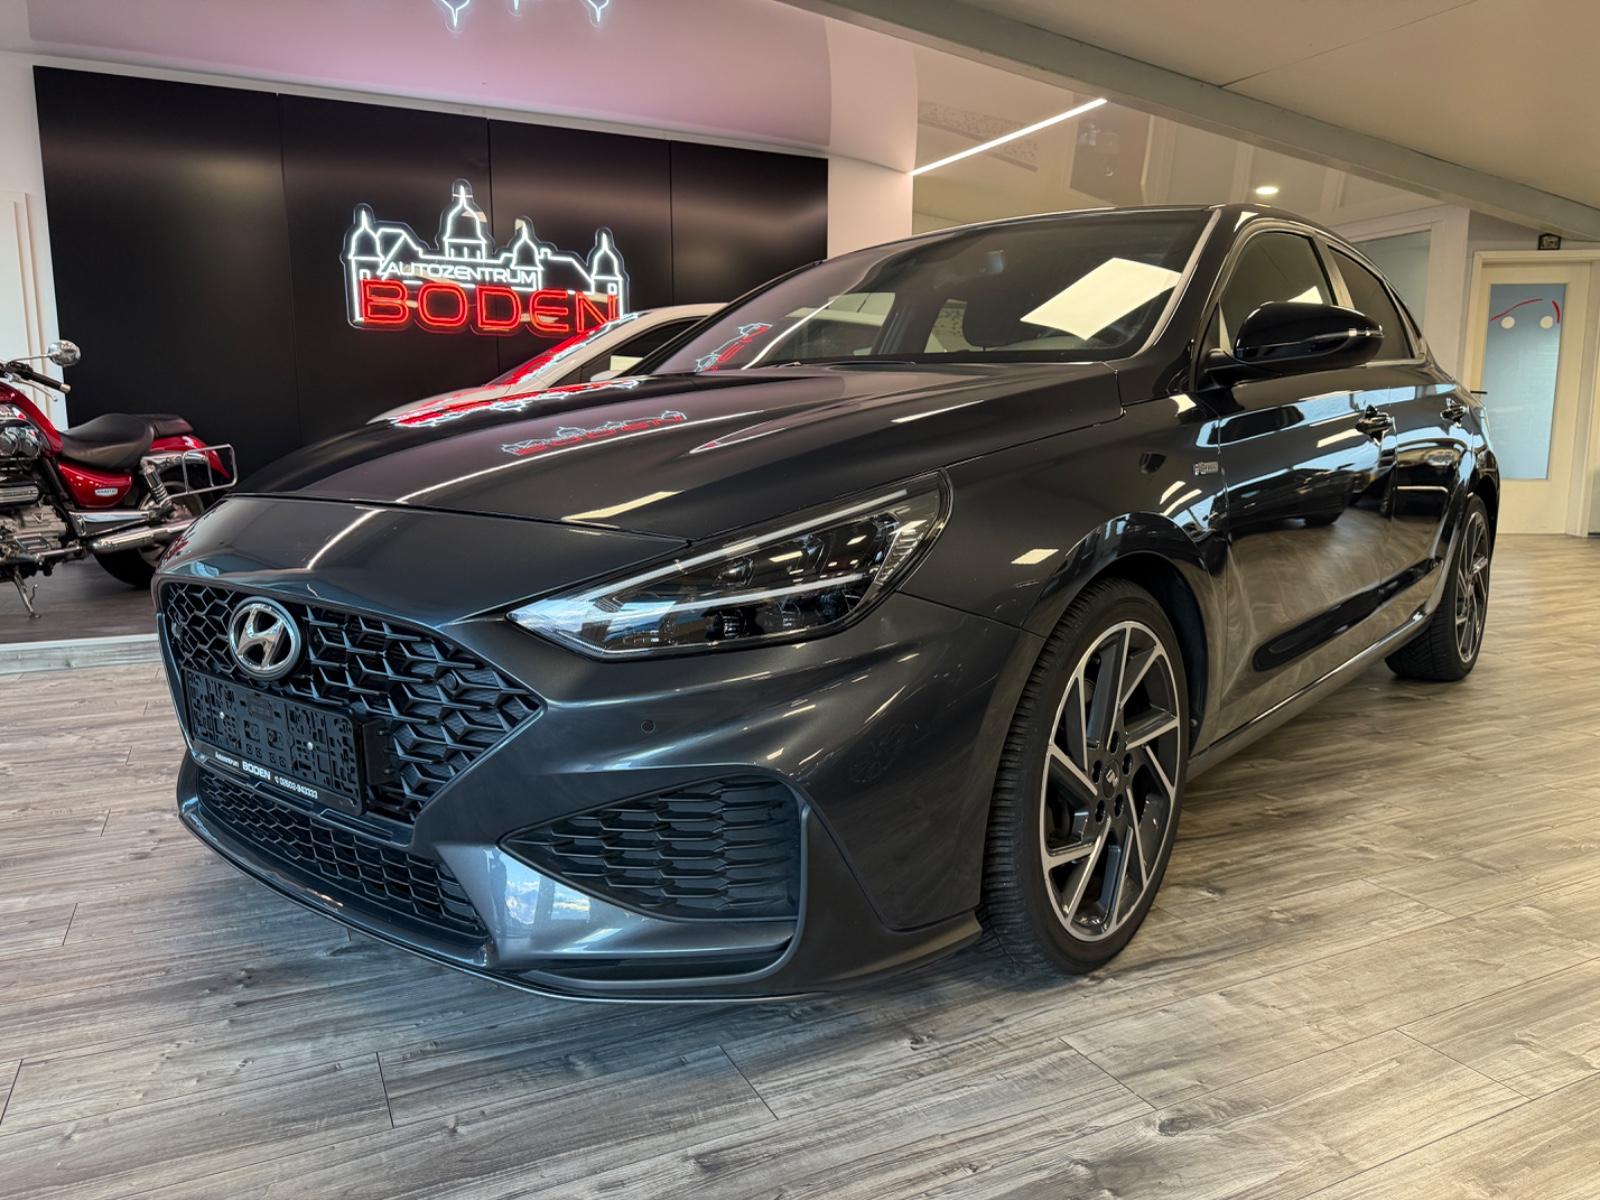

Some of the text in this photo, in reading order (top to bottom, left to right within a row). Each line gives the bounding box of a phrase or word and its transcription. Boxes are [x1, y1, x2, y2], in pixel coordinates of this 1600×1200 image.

[383, 262, 537, 285] AUTOZENTRUM
[360, 278, 618, 333] BODEN
[242, 760, 271, 780] BODEN
